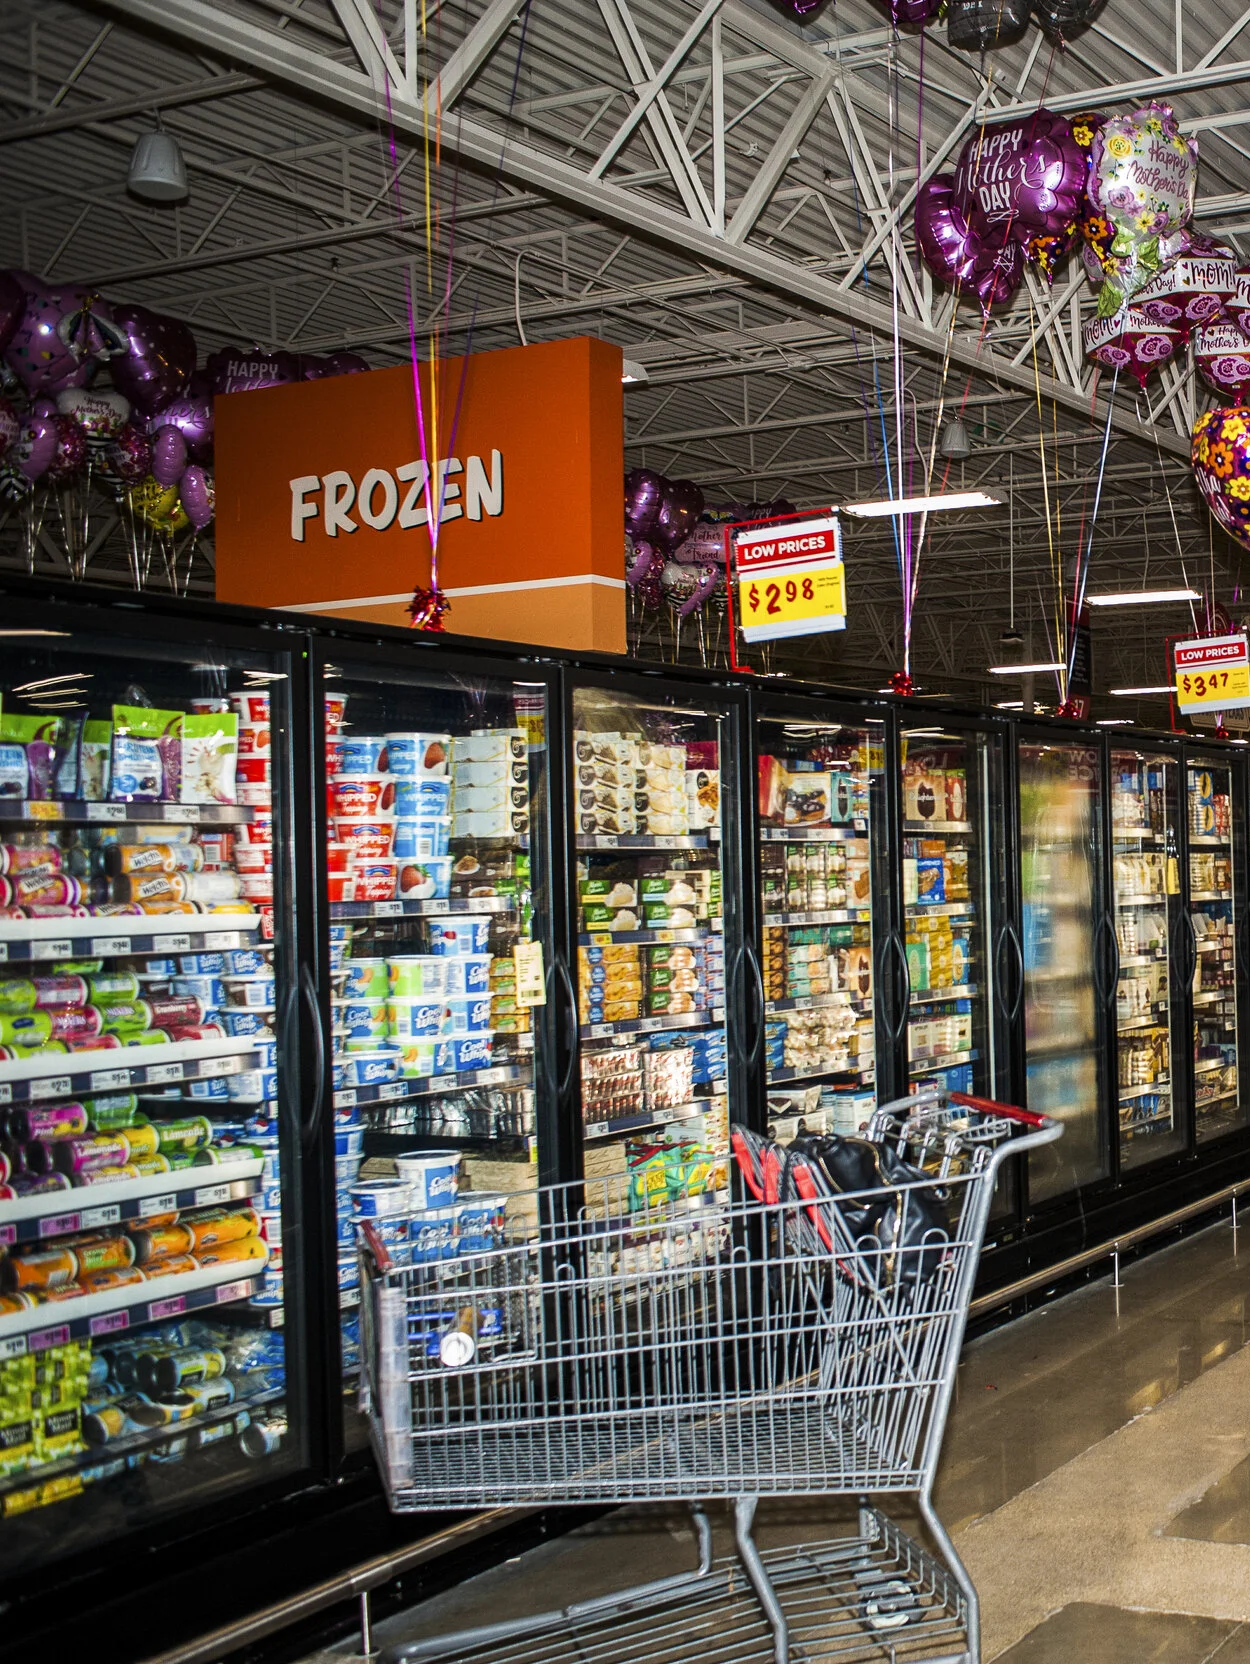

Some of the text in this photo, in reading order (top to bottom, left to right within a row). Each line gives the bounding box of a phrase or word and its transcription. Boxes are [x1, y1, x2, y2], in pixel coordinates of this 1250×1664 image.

[969, 129, 1023, 162] HAPPY
[1149, 140, 1189, 178] Happy
[979, 182, 1012, 213] DAY
[1156, 274, 1176, 292] Day!
[227, 360, 279, 379] HAPPY
[289, 448, 503, 542] FROZEN
[744, 535, 826, 560] LOW PRICES
[1181, 645, 1240, 661] LOW PRICES
